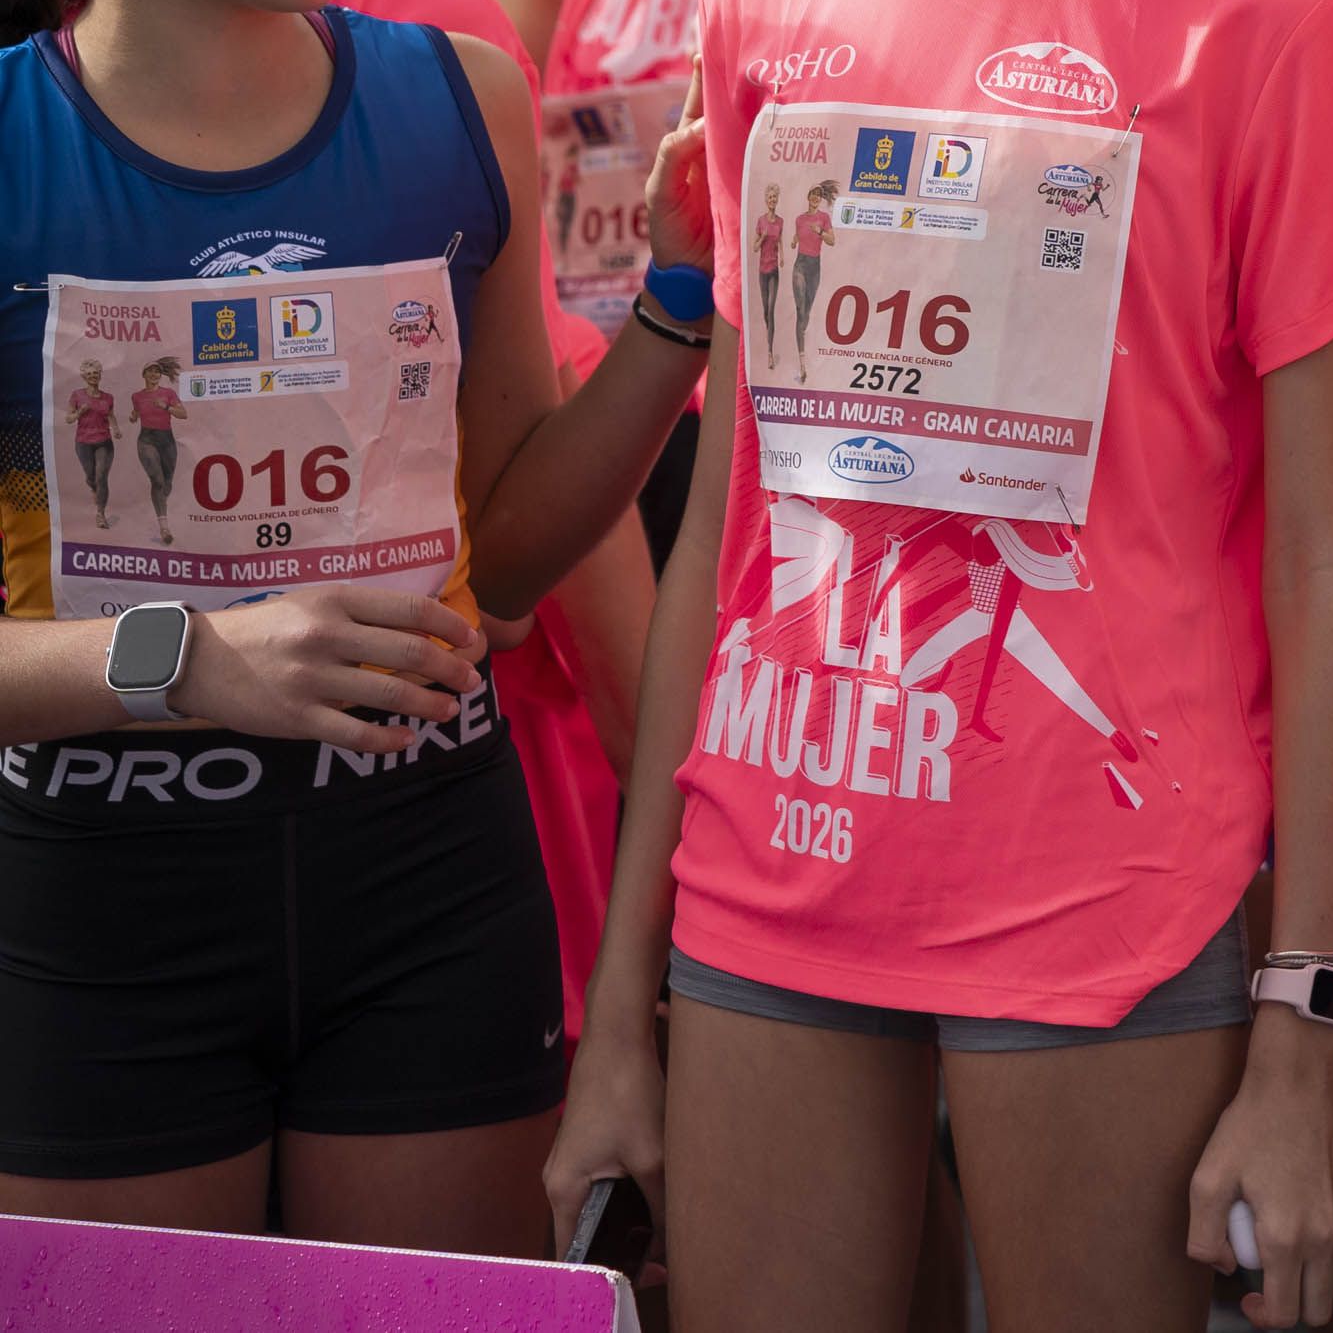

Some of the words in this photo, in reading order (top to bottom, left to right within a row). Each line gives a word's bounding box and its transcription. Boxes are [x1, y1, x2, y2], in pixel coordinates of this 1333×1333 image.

[1012, 60, 1057, 73] CENTRAL
[984, 61, 1105, 108] ASTURIANA
[775, 127, 785, 138] TU
[788, 128, 830, 140] DORSAL
[770, 141, 828, 164] SUMA
[854, 180, 871, 188] Gran
[873, 181, 902, 191] Canaria
[859, 172, 884, 181] Cabildo
[190, 246, 216, 267] CLUB
[218, 230, 271, 249] ATLÉTICO
[275, 230, 326, 246] INSULAR
[83, 302, 97, 316] TU
[100, 306, 160, 318] DORSAL
[825, 284, 971, 355] 016
[85, 317, 161, 342] SUMA
[199, 352, 219, 360] Gran
[202, 342, 235, 352] Cabildo
[817, 348, 855, 358] TELÉFONO
[856, 351, 900, 362] VIOLENCIA
[902, 355, 914, 363] DE
[915, 356, 952, 367] GÉNERO
[850, 363, 922, 395] 2572
[755, 395, 798, 417] CARRERA
[801, 399, 815, 418] DE
[818, 402, 834, 419] LA
[840, 402, 904, 426] MUJER
[923, 410, 978, 435] GRAN
[984, 418, 1074, 447] CANARIA
[193, 445, 351, 511] 016
[832, 454, 906, 475] ASTURIANA
[978, 472, 1047, 491] Santander
[256, 522, 292, 549] 89
[72, 551, 160, 576] CARRERA
[168, 556, 193, 579] DE
[200, 562, 223, 580] LA
[231, 558, 299, 581] MUJER
[319, 551, 371, 574] GRAN
[376, 538, 444, 565] CANARIA
[820, 527, 901, 675] LA
[314, 678, 494, 787] NIKE
[701, 640, 959, 802] MUJER
[45, 747, 262, 802] PRO
[769, 794, 853, 864] 2026
